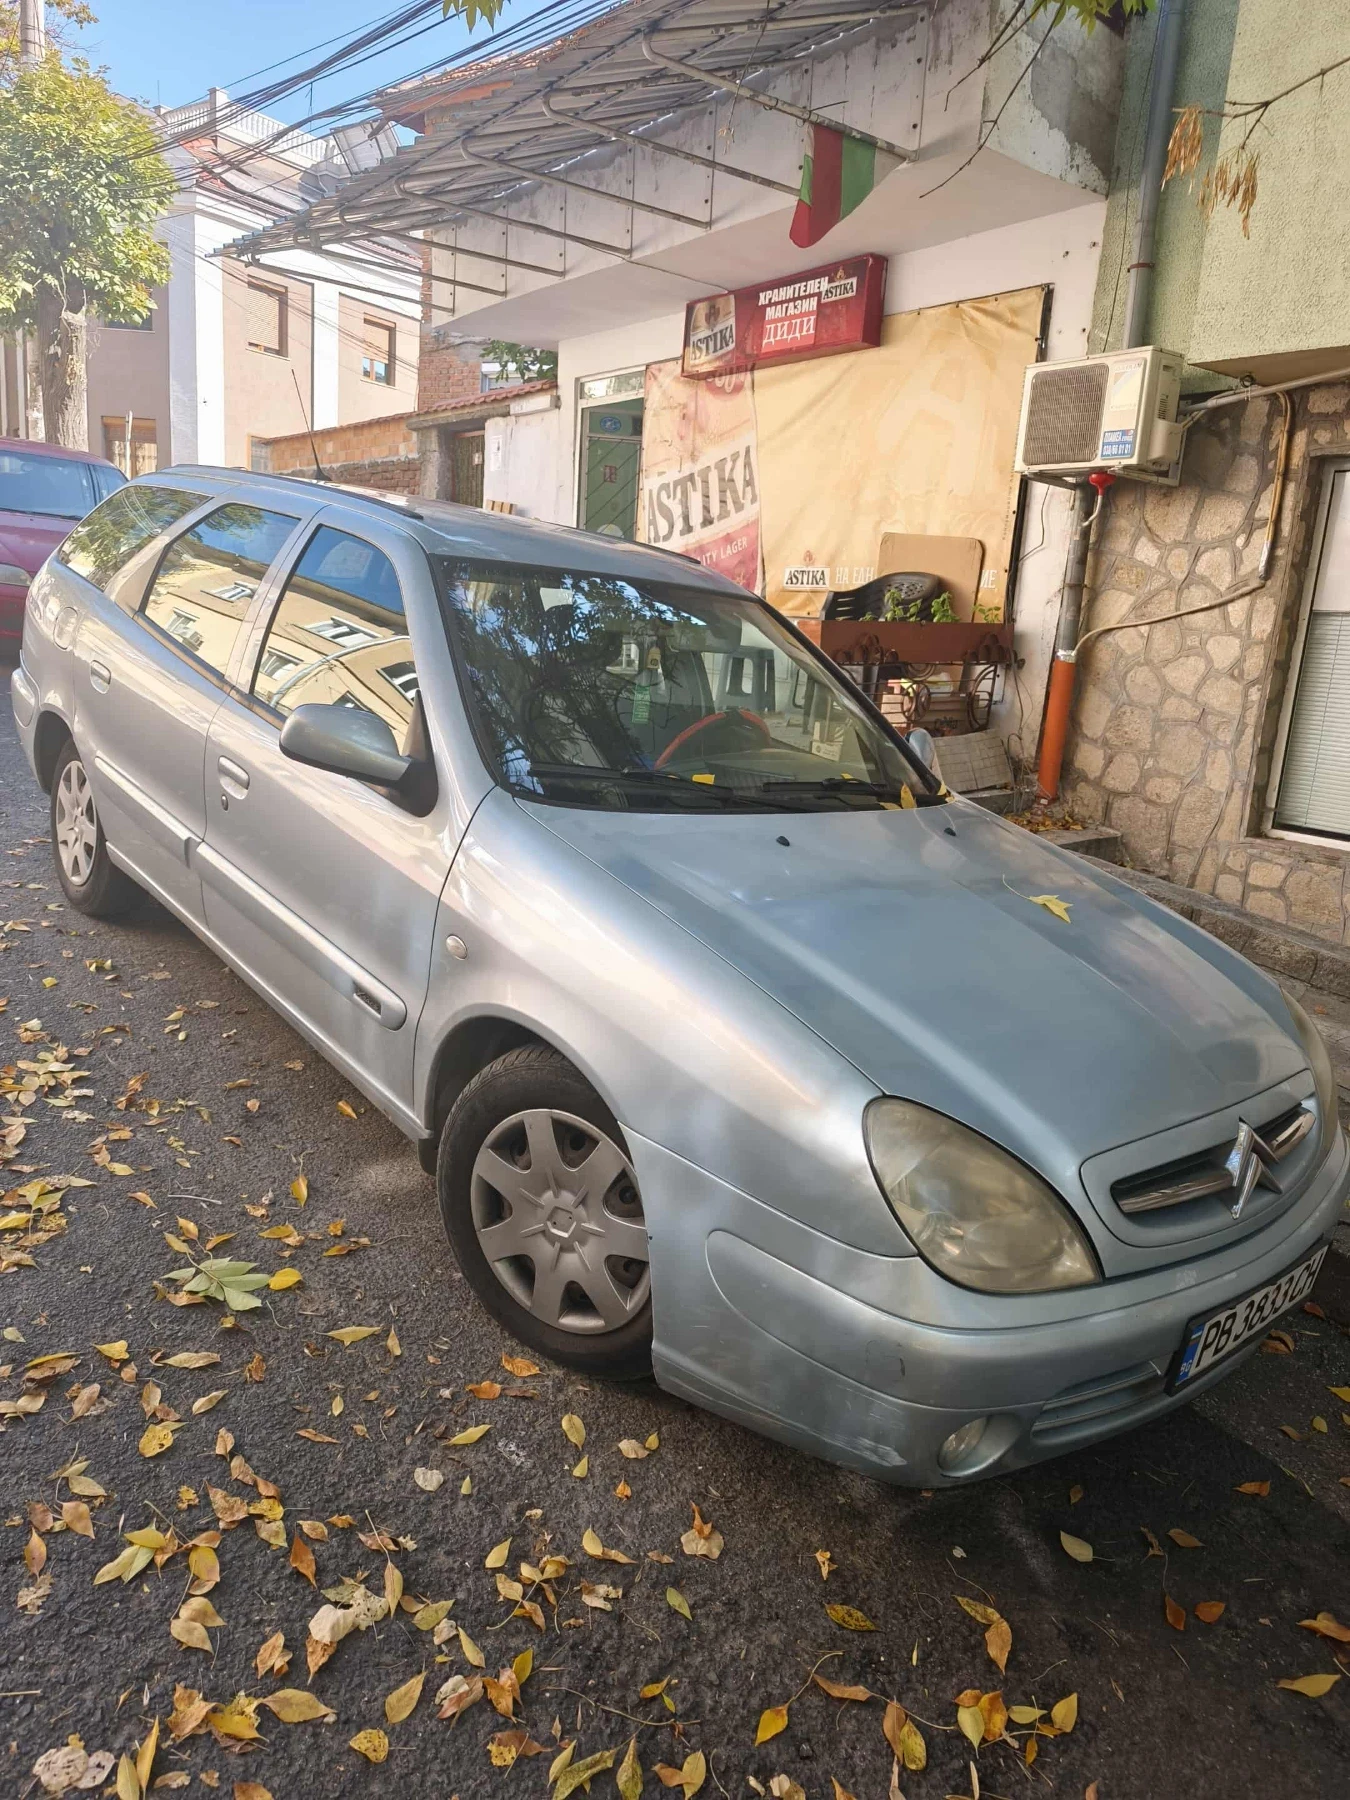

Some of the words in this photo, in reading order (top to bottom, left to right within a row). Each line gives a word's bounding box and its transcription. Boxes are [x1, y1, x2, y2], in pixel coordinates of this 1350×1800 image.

[758, 276, 829, 306] ХРАНИТЕЛЕН
[823, 281, 855, 300] ASTIKA
[765, 296, 818, 321] МАГАЗИН
[691, 324, 735, 361] ASTIKA
[762, 316, 816, 348] ДИДИ
[648, 444, 758, 544] ASTIKA
[720, 536, 748, 559] LAGER
[785, 569, 827, 586] ASTIKA
[1195, 1311, 1237, 1368] PB
[1233, 1276, 1295, 1342] 3833
[1288, 1254, 1325, 1302] CH
[1180, 1360, 1193, 1376] BG
